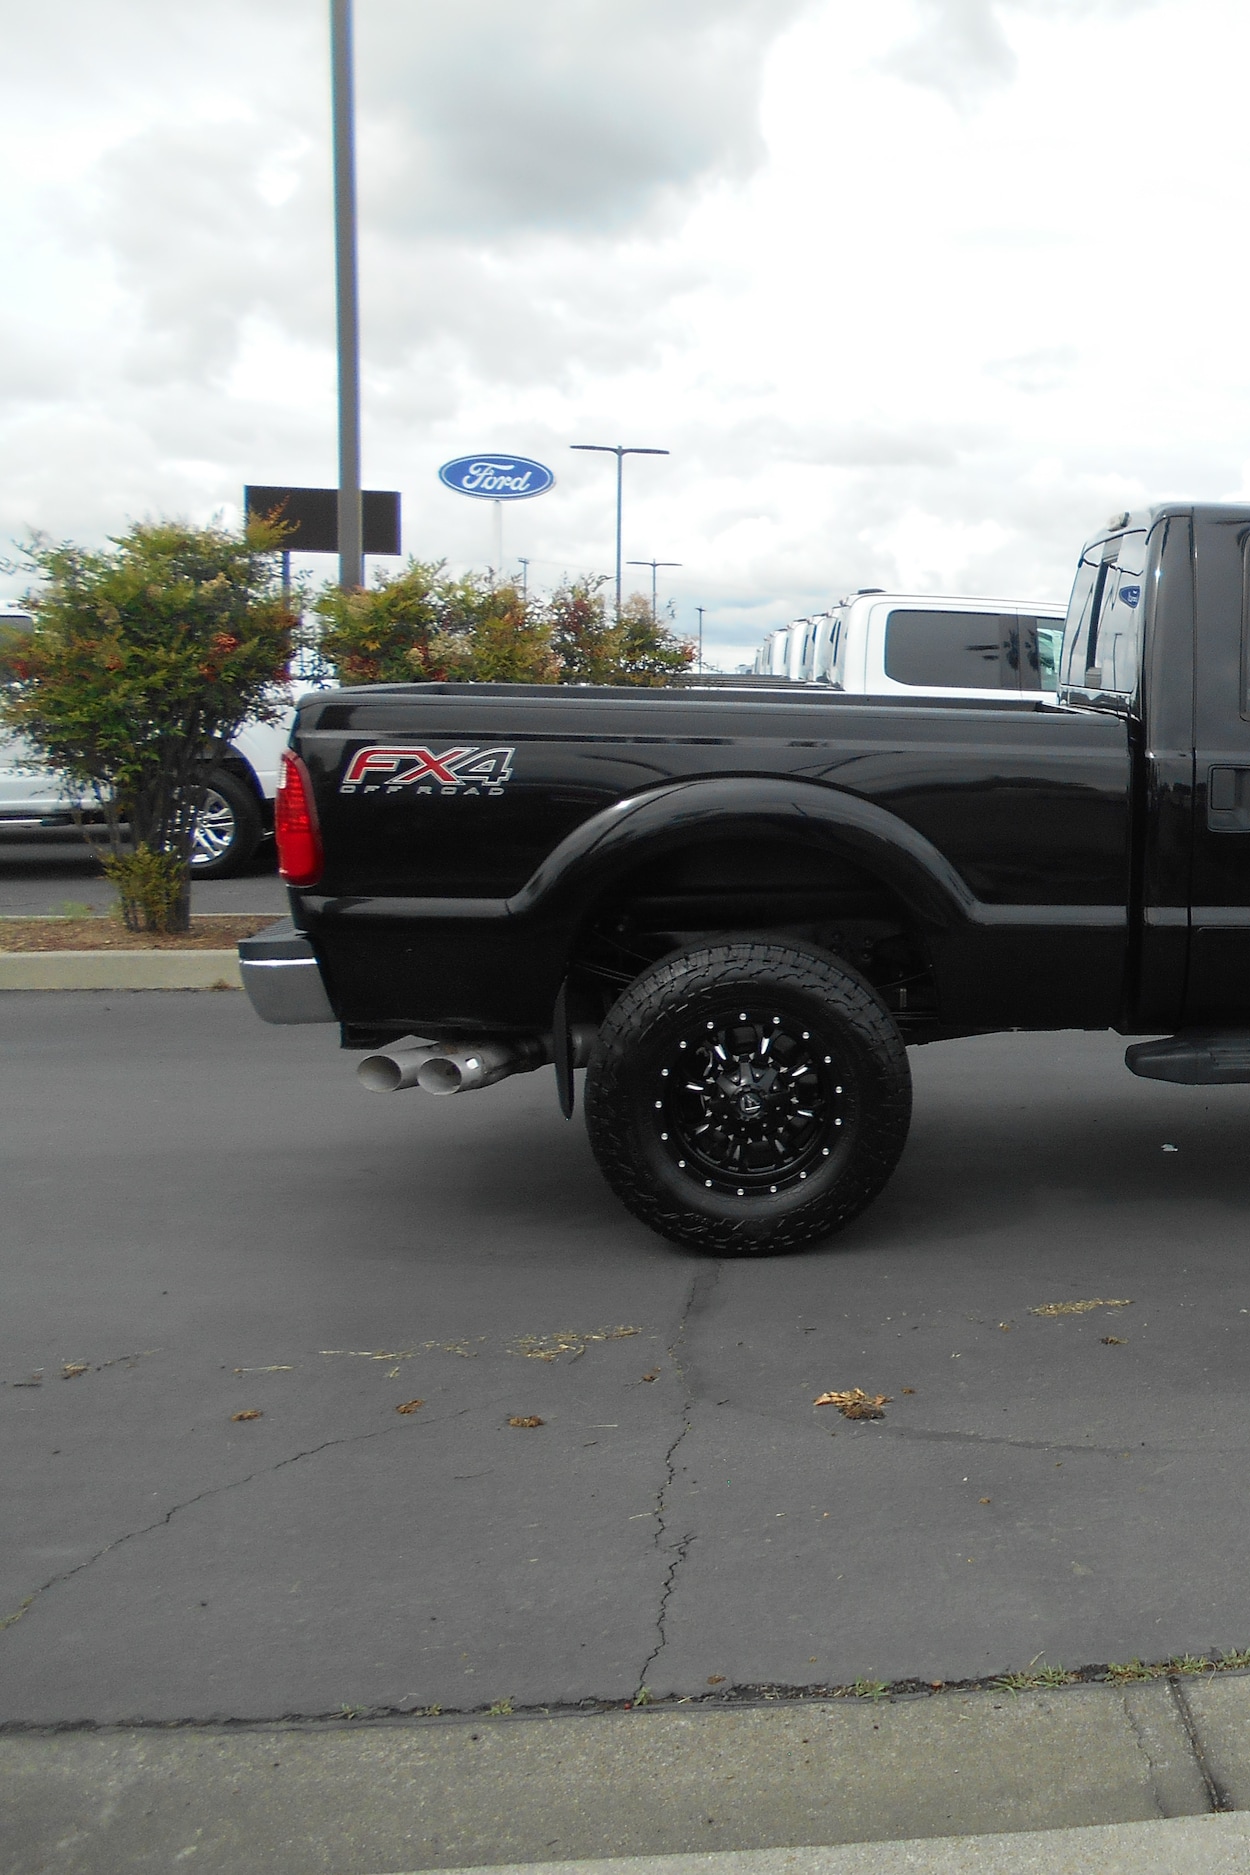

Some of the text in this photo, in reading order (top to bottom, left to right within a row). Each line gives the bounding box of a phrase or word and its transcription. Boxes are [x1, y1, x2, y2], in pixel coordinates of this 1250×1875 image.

[462, 462, 532, 490] Ford
[342, 745, 516, 786] FX4
[339, 785, 505, 796] OFF ROAD
